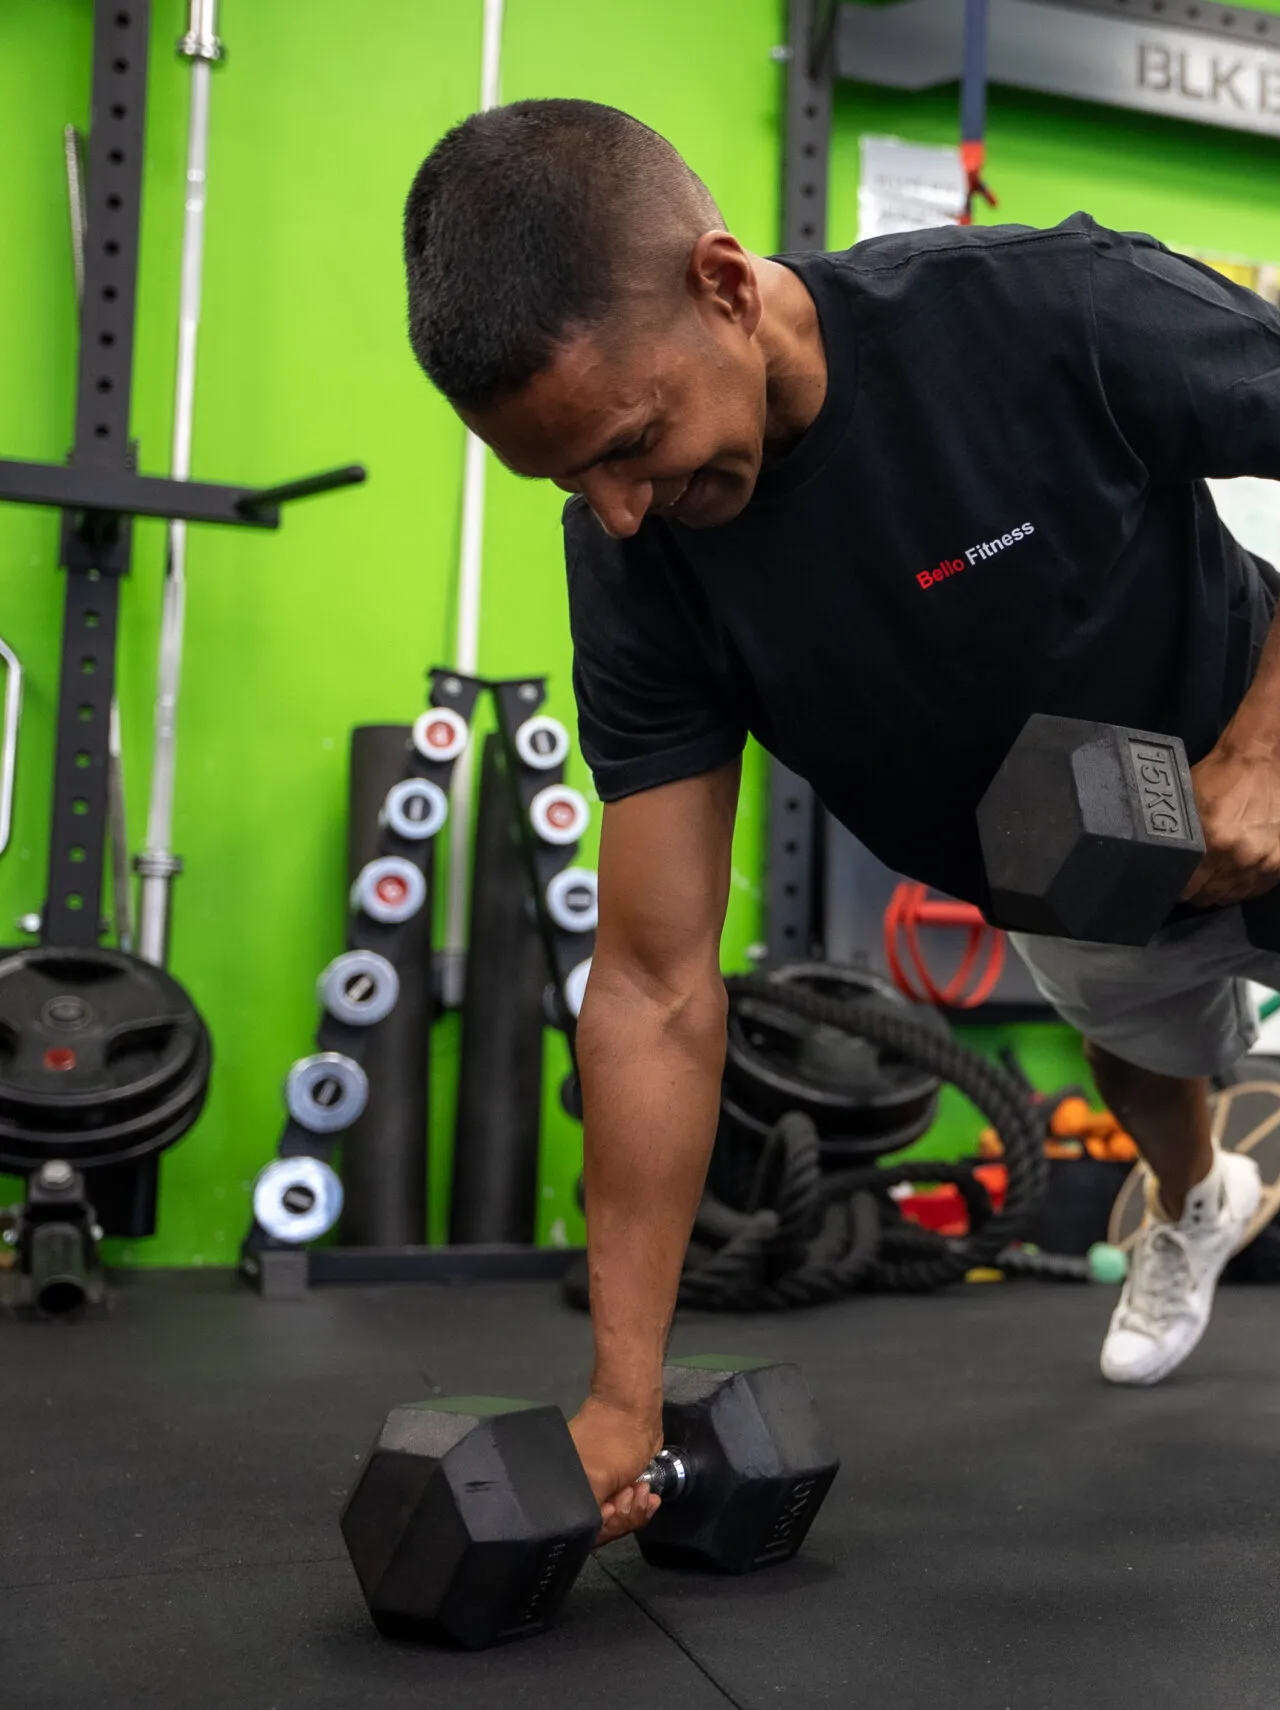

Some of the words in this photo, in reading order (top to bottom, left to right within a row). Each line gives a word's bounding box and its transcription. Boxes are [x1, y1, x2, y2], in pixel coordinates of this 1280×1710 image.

[916, 559, 965, 589] Bello
[965, 522, 1035, 566] Fitness
[1137, 751, 1178, 834] 15KG
